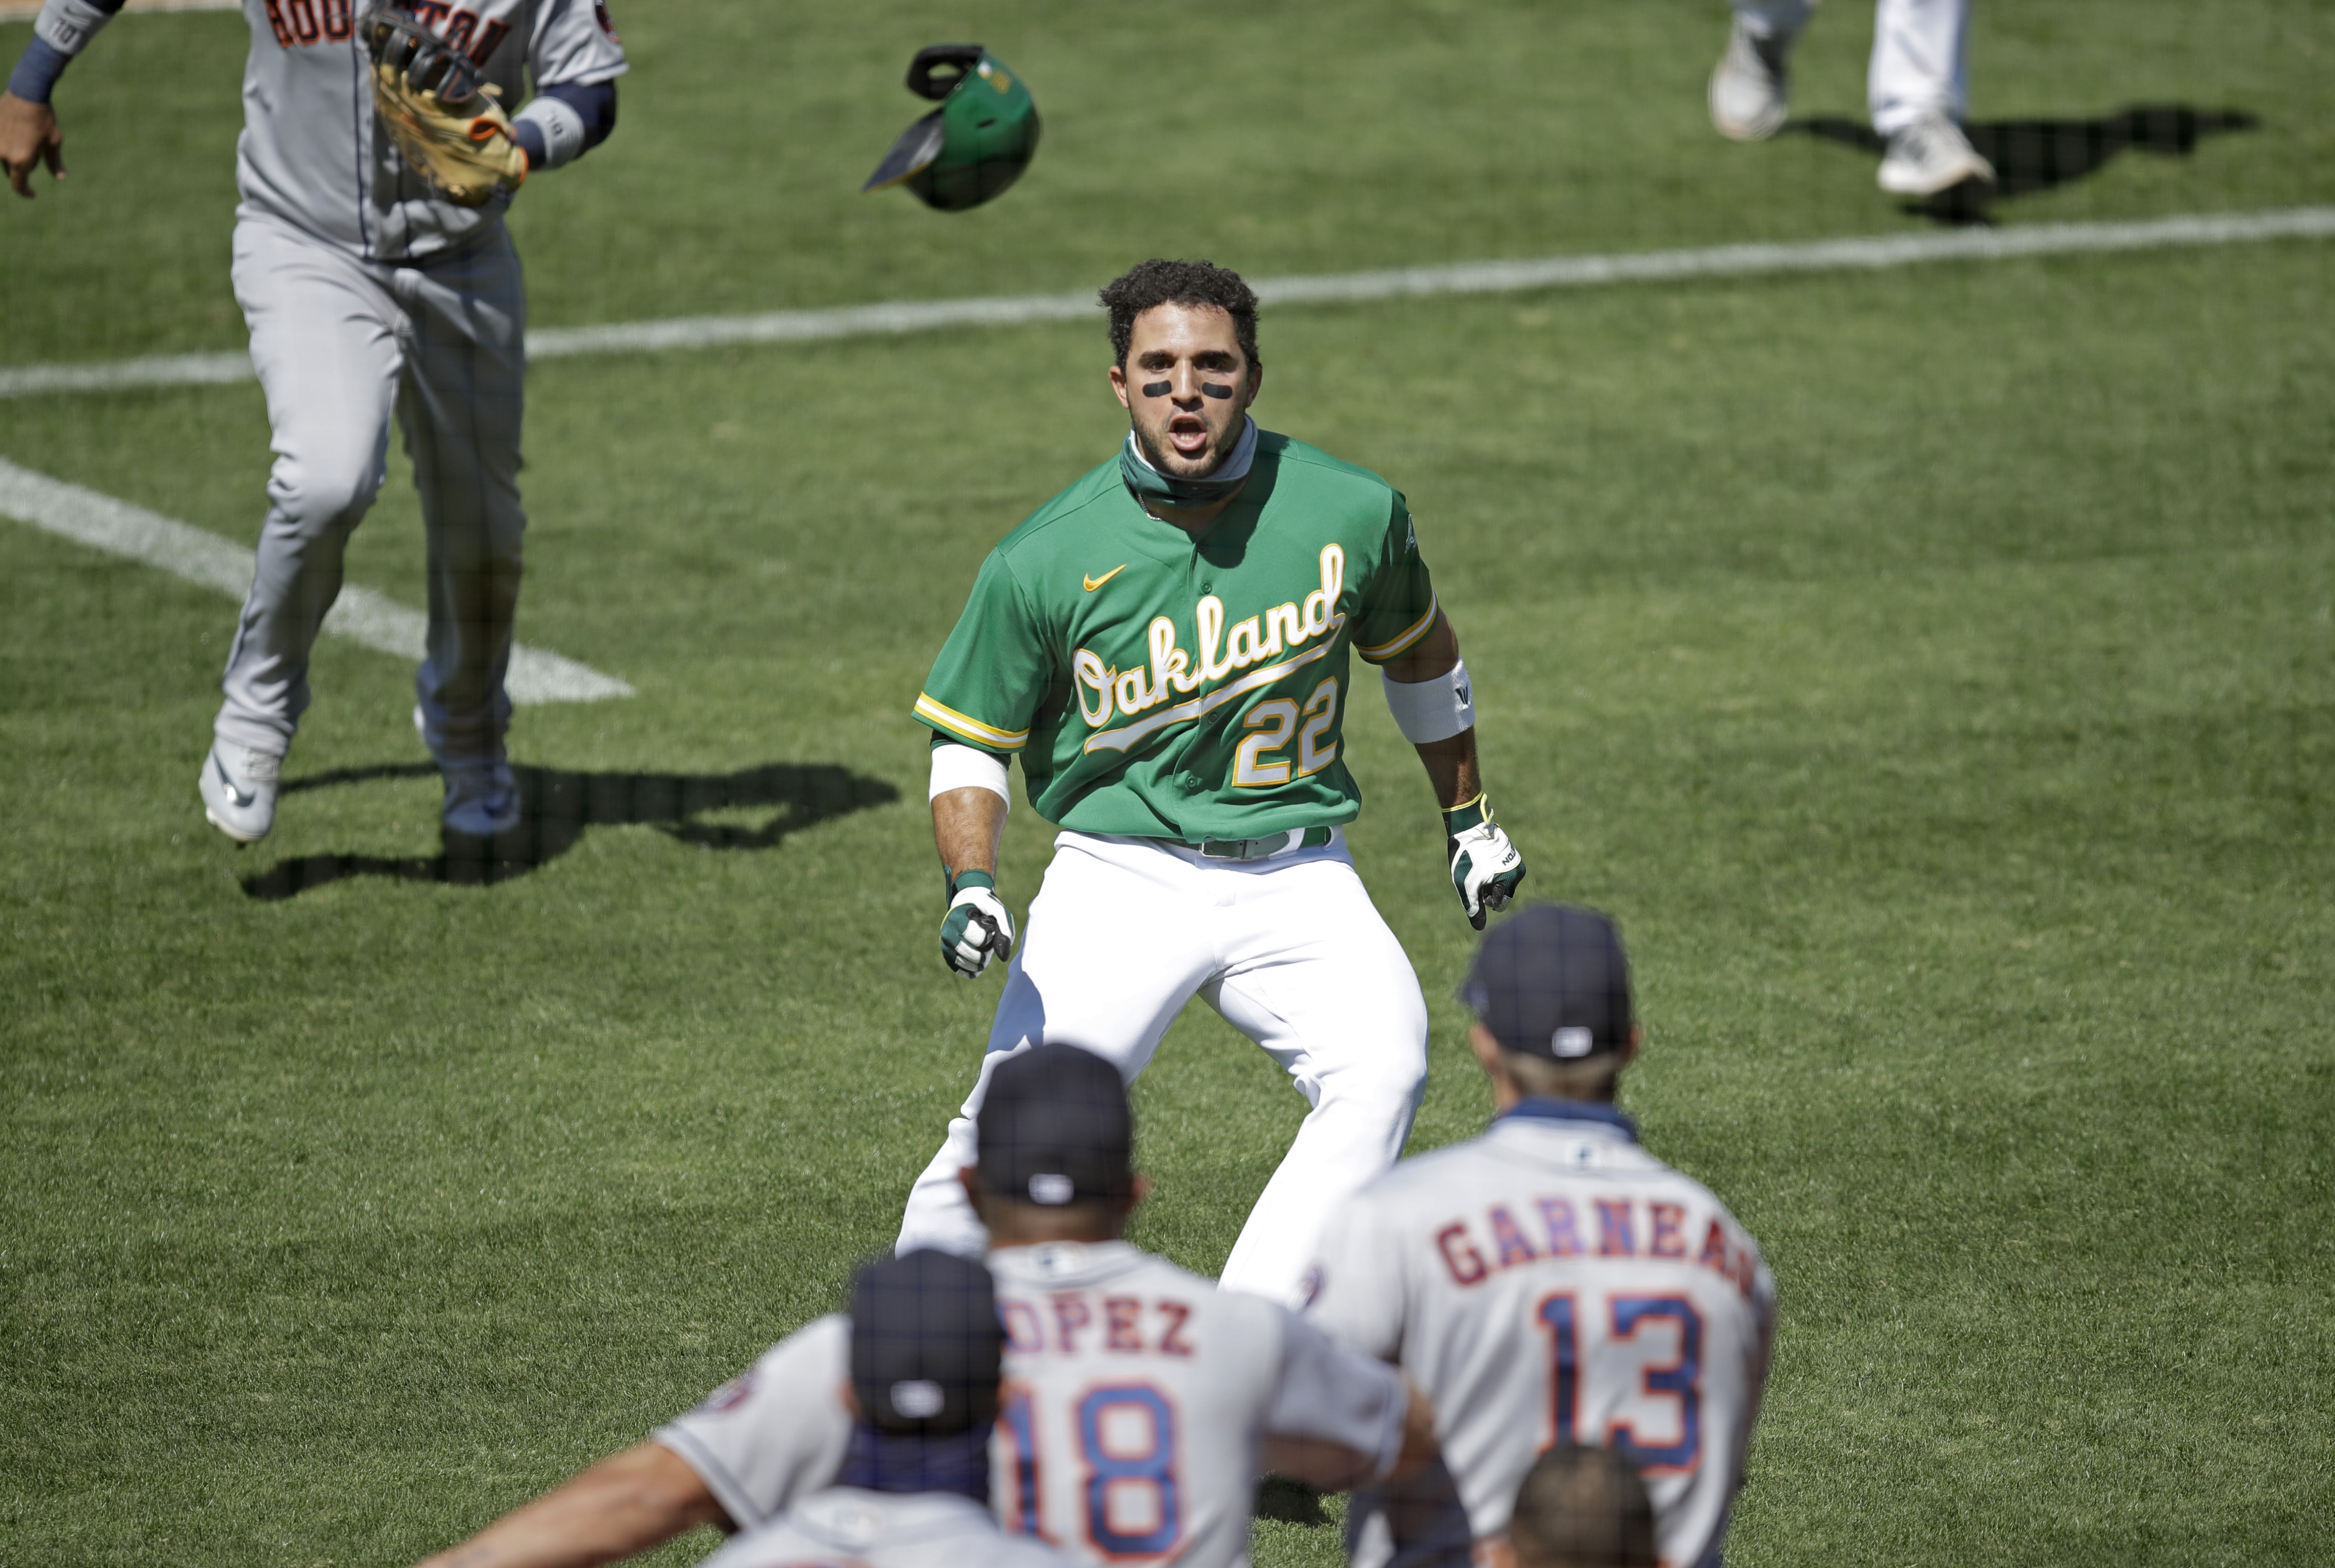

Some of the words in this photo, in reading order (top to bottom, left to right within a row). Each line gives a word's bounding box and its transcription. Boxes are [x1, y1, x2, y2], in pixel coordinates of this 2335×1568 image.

[265, 0, 514, 68] HOUTON
[1073, 543, 1346, 727] Oakland
[1232, 676, 1338, 787] 22
[995, 1291, 1194, 1357] OPEZ
[1535, 1285, 1705, 1478] 13
[994, 1379, 1185, 1565] 18
